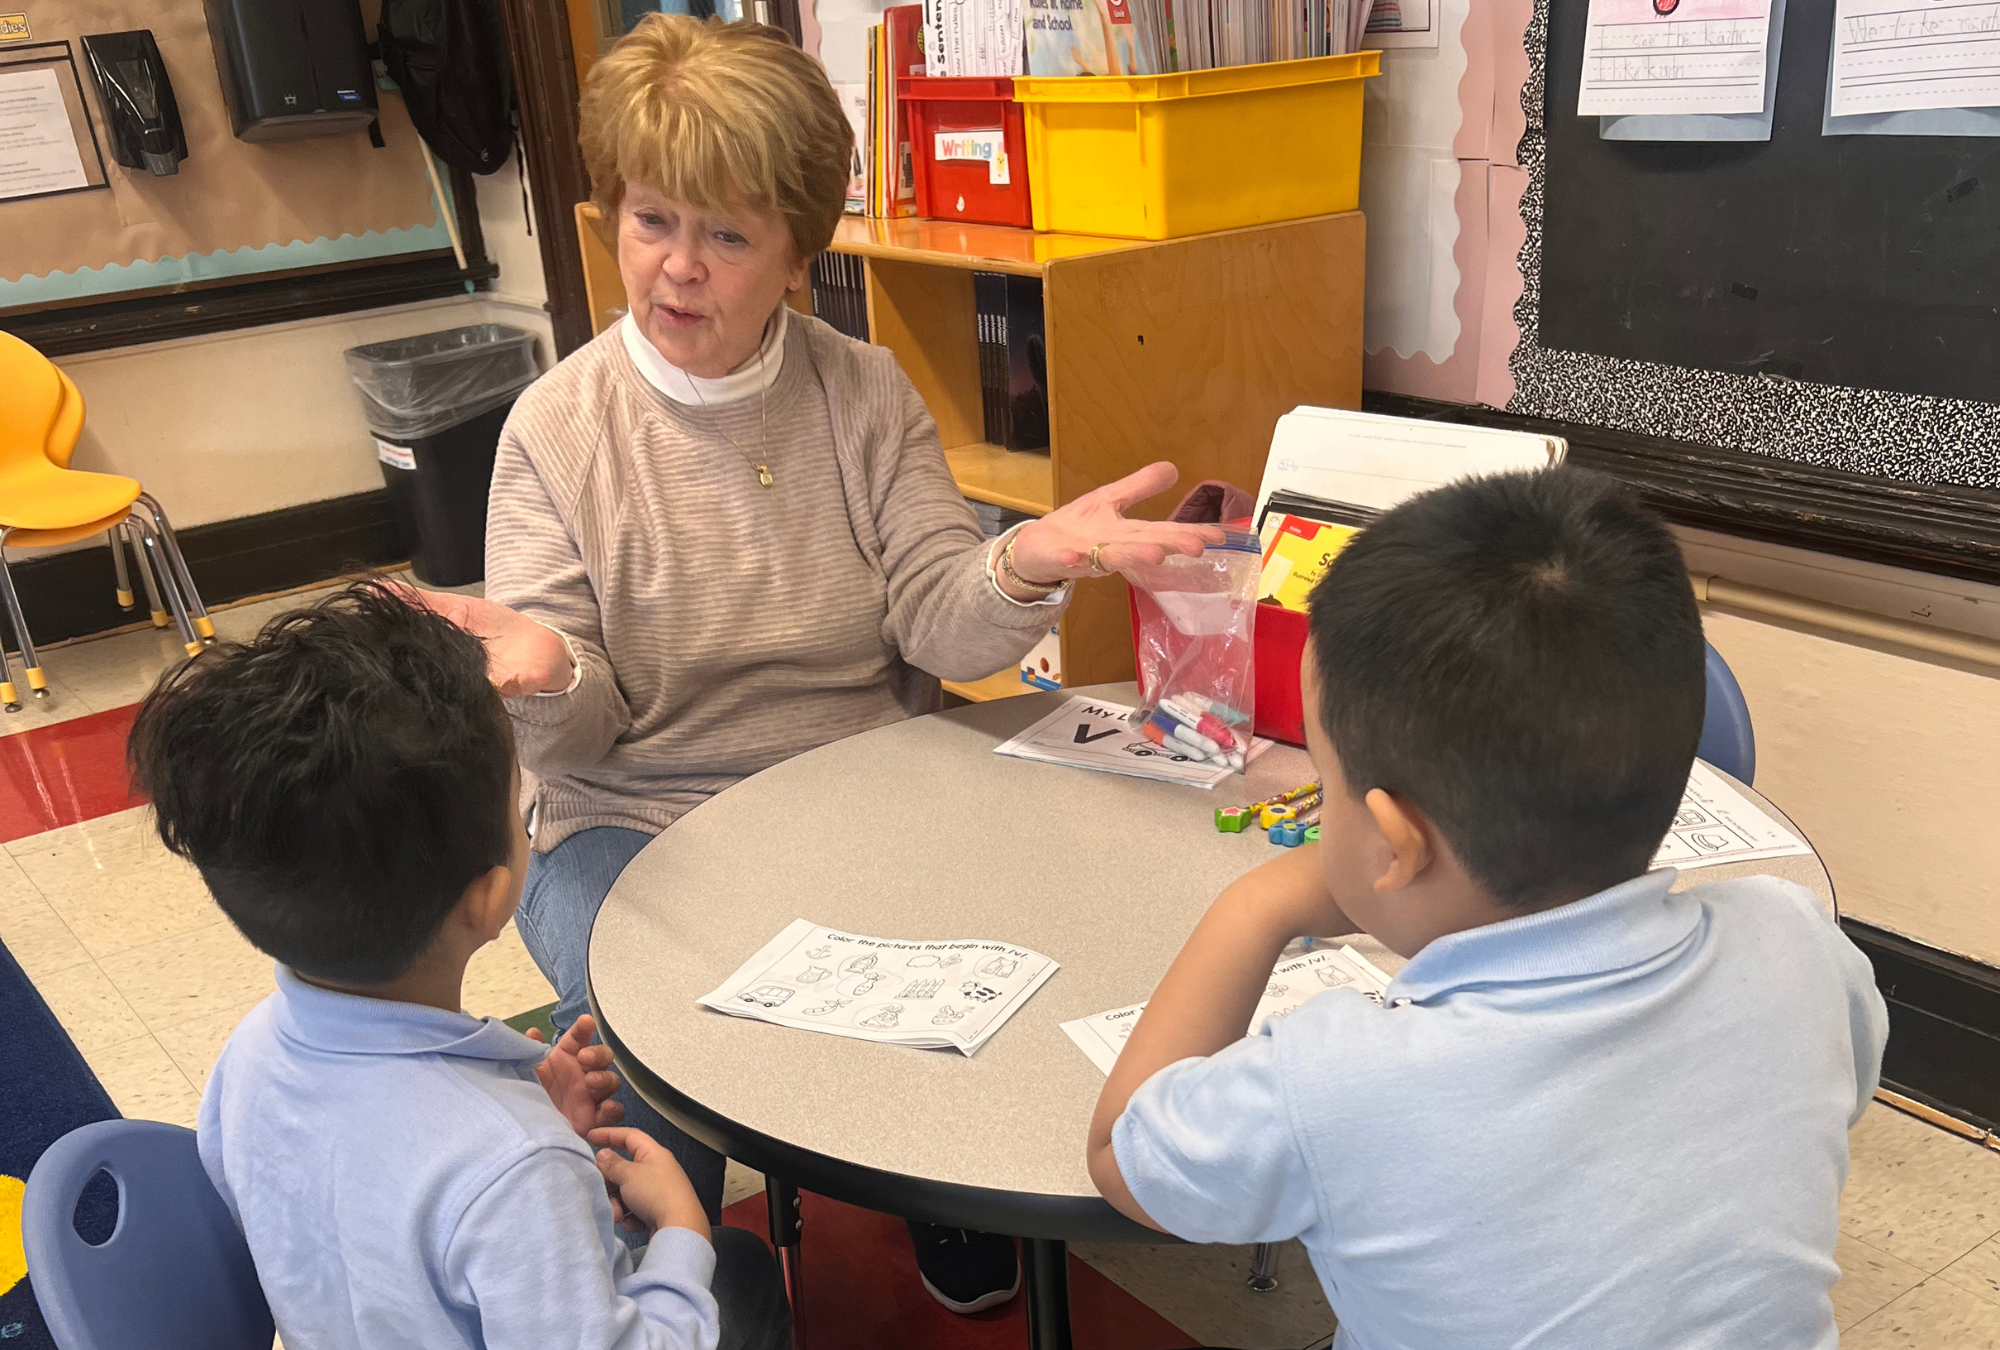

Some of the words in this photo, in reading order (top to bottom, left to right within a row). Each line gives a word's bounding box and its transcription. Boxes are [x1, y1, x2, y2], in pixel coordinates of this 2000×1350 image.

[1032, 14, 1046, 29] and
[1047, 14, 1073, 31] School
[942, 139, 992, 159] Writing
[1081, 706, 1115, 718] My
[1073, 724, 1122, 744] V
[827, 933, 855, 943] Color
[857, 939, 875, 947] the
[876, 943, 921, 951] pictures
[948, 943, 978, 951] begin
[982, 944, 1006, 952] with
[1278, 962, 1306, 973] with
[1105, 1009, 1137, 1021] Color
